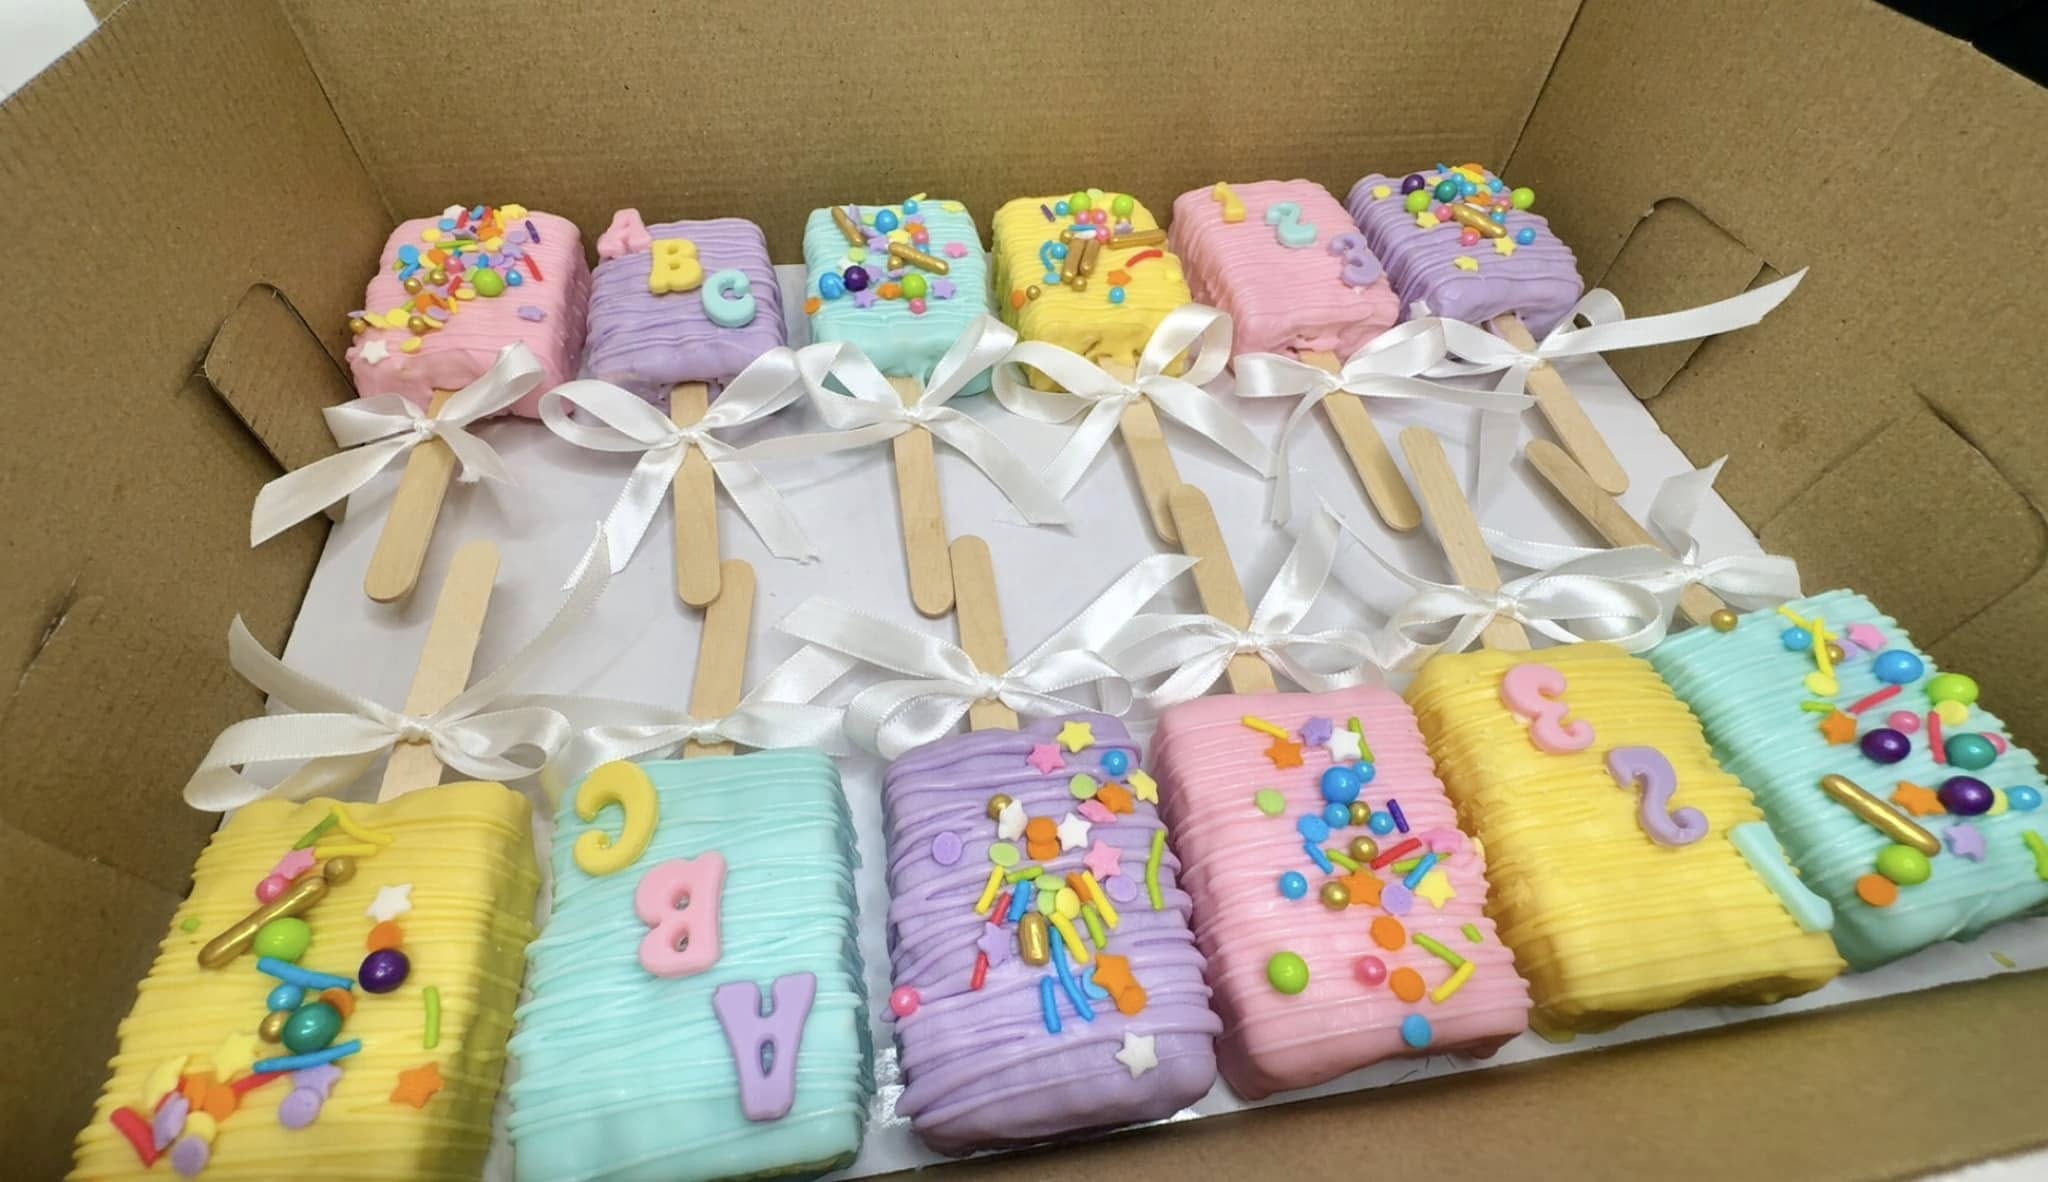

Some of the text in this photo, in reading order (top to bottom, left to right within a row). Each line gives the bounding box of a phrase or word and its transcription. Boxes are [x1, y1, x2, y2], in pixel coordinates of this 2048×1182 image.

[597, 208, 756, 328] A B C
[1213, 181, 1383, 287] 1 2 3
[1502, 663, 1595, 754] 3
[1607, 745, 1709, 847] 2
[573, 760, 817, 1122] A B C
